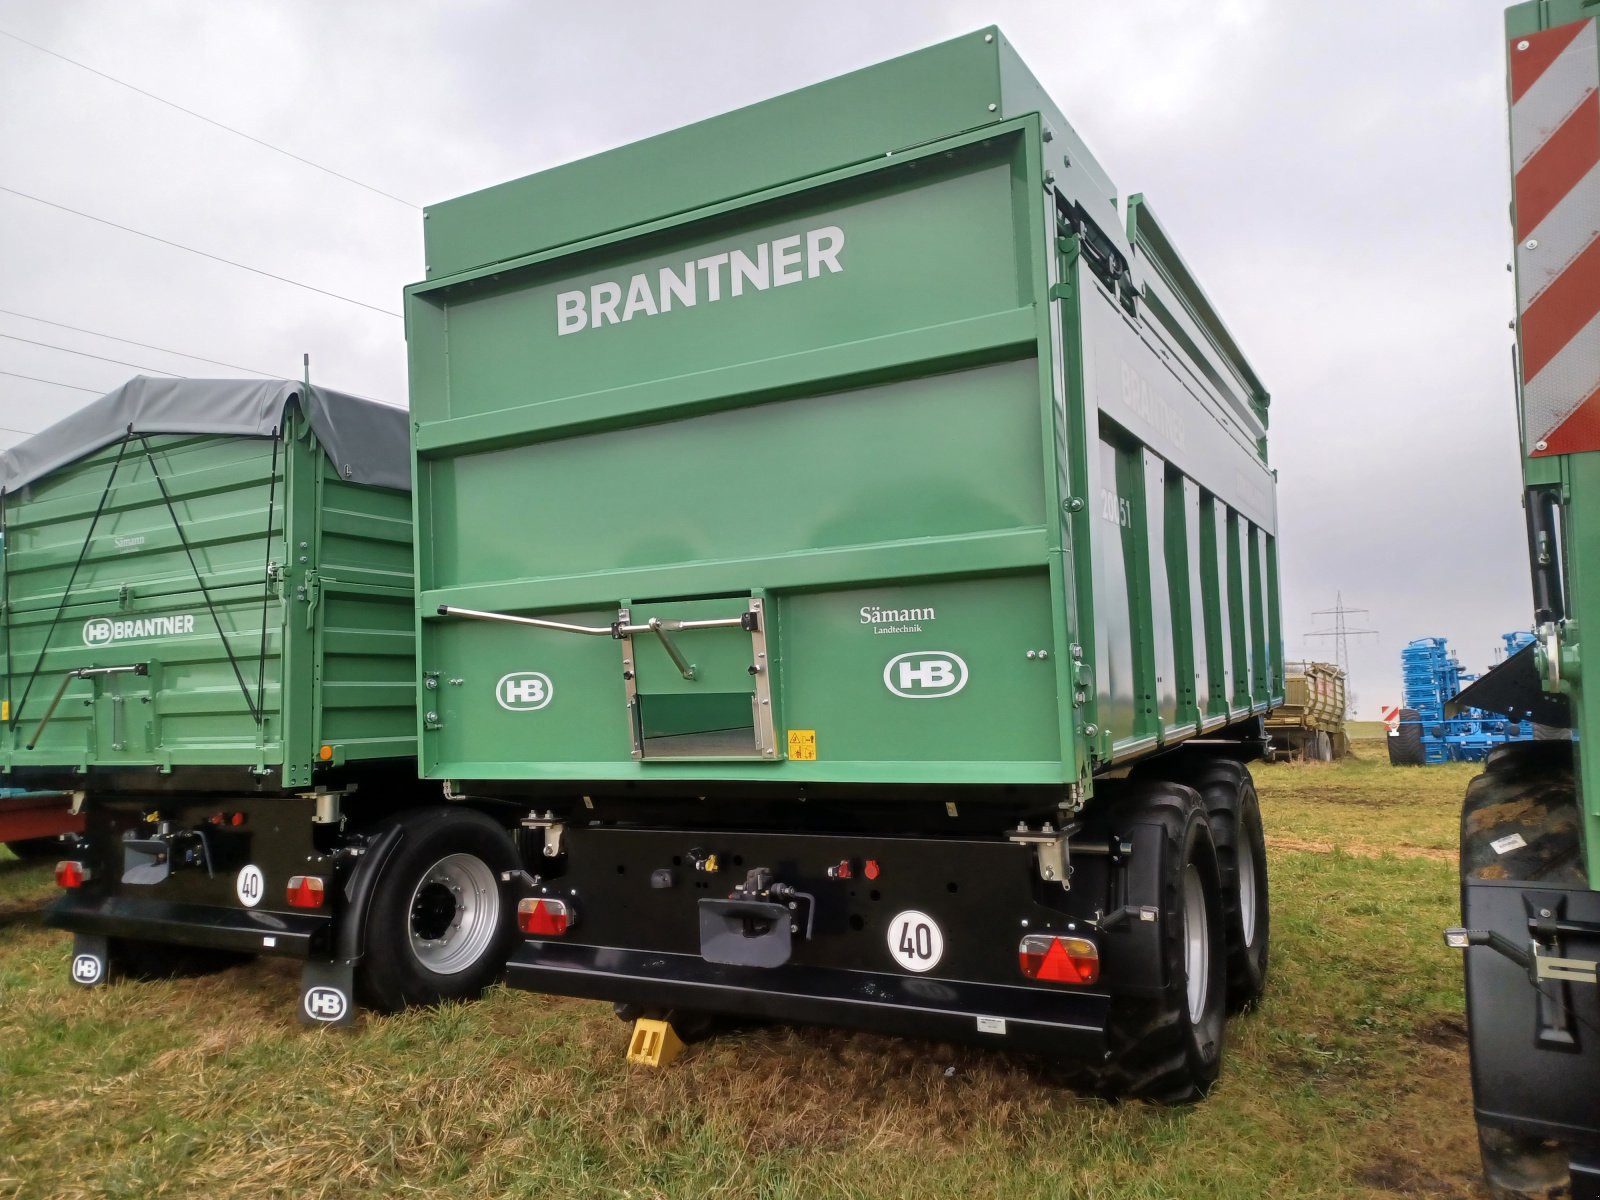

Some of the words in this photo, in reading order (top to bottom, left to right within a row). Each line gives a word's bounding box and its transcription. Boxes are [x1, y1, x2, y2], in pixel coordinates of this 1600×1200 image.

[556, 225, 845, 336] BRANTNER
[860, 606, 936, 624] Sämann
[88, 623, 110, 641] HB
[114, 614, 194, 640] BRANTNER
[873, 624, 922, 634] Landtechnik
[899, 660, 955, 689] HB
[506, 679, 544, 703] HB
[242, 873, 258, 898] 40
[899, 922, 932, 960] 40
[76, 960, 96, 978] HB
[312, 993, 340, 1014] HB
